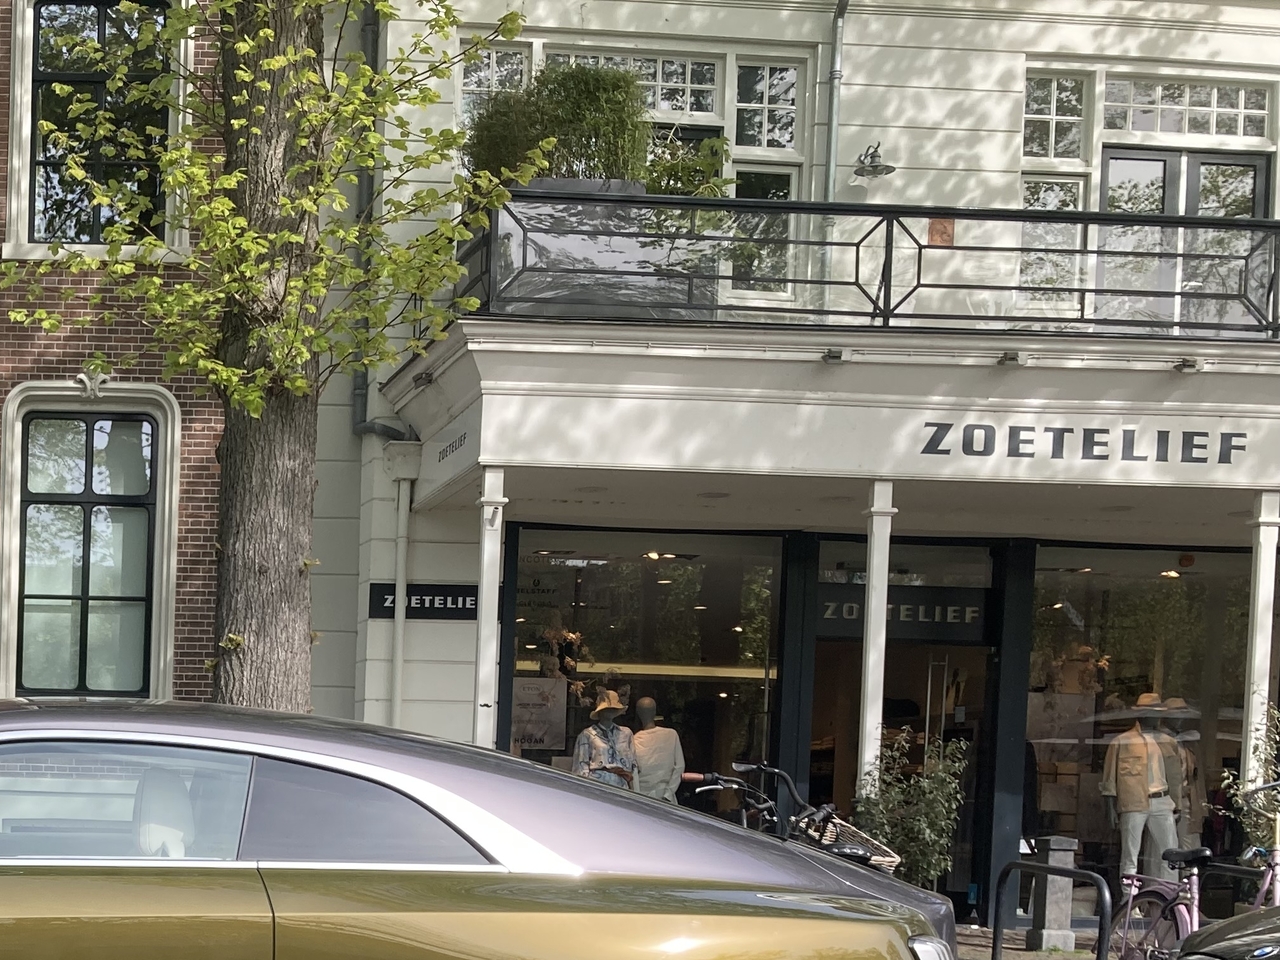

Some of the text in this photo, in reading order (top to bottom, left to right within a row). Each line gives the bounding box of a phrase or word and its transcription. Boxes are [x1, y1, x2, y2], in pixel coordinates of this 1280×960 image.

[438, 432, 467, 463] ZOETELIEF
[920, 421, 1248, 464] ZOETELIEF
[383, 595, 476, 609] ZETELIE
[823, 602, 980, 623] ZOTELIEF
[514, 737, 545, 745] HOGAN
